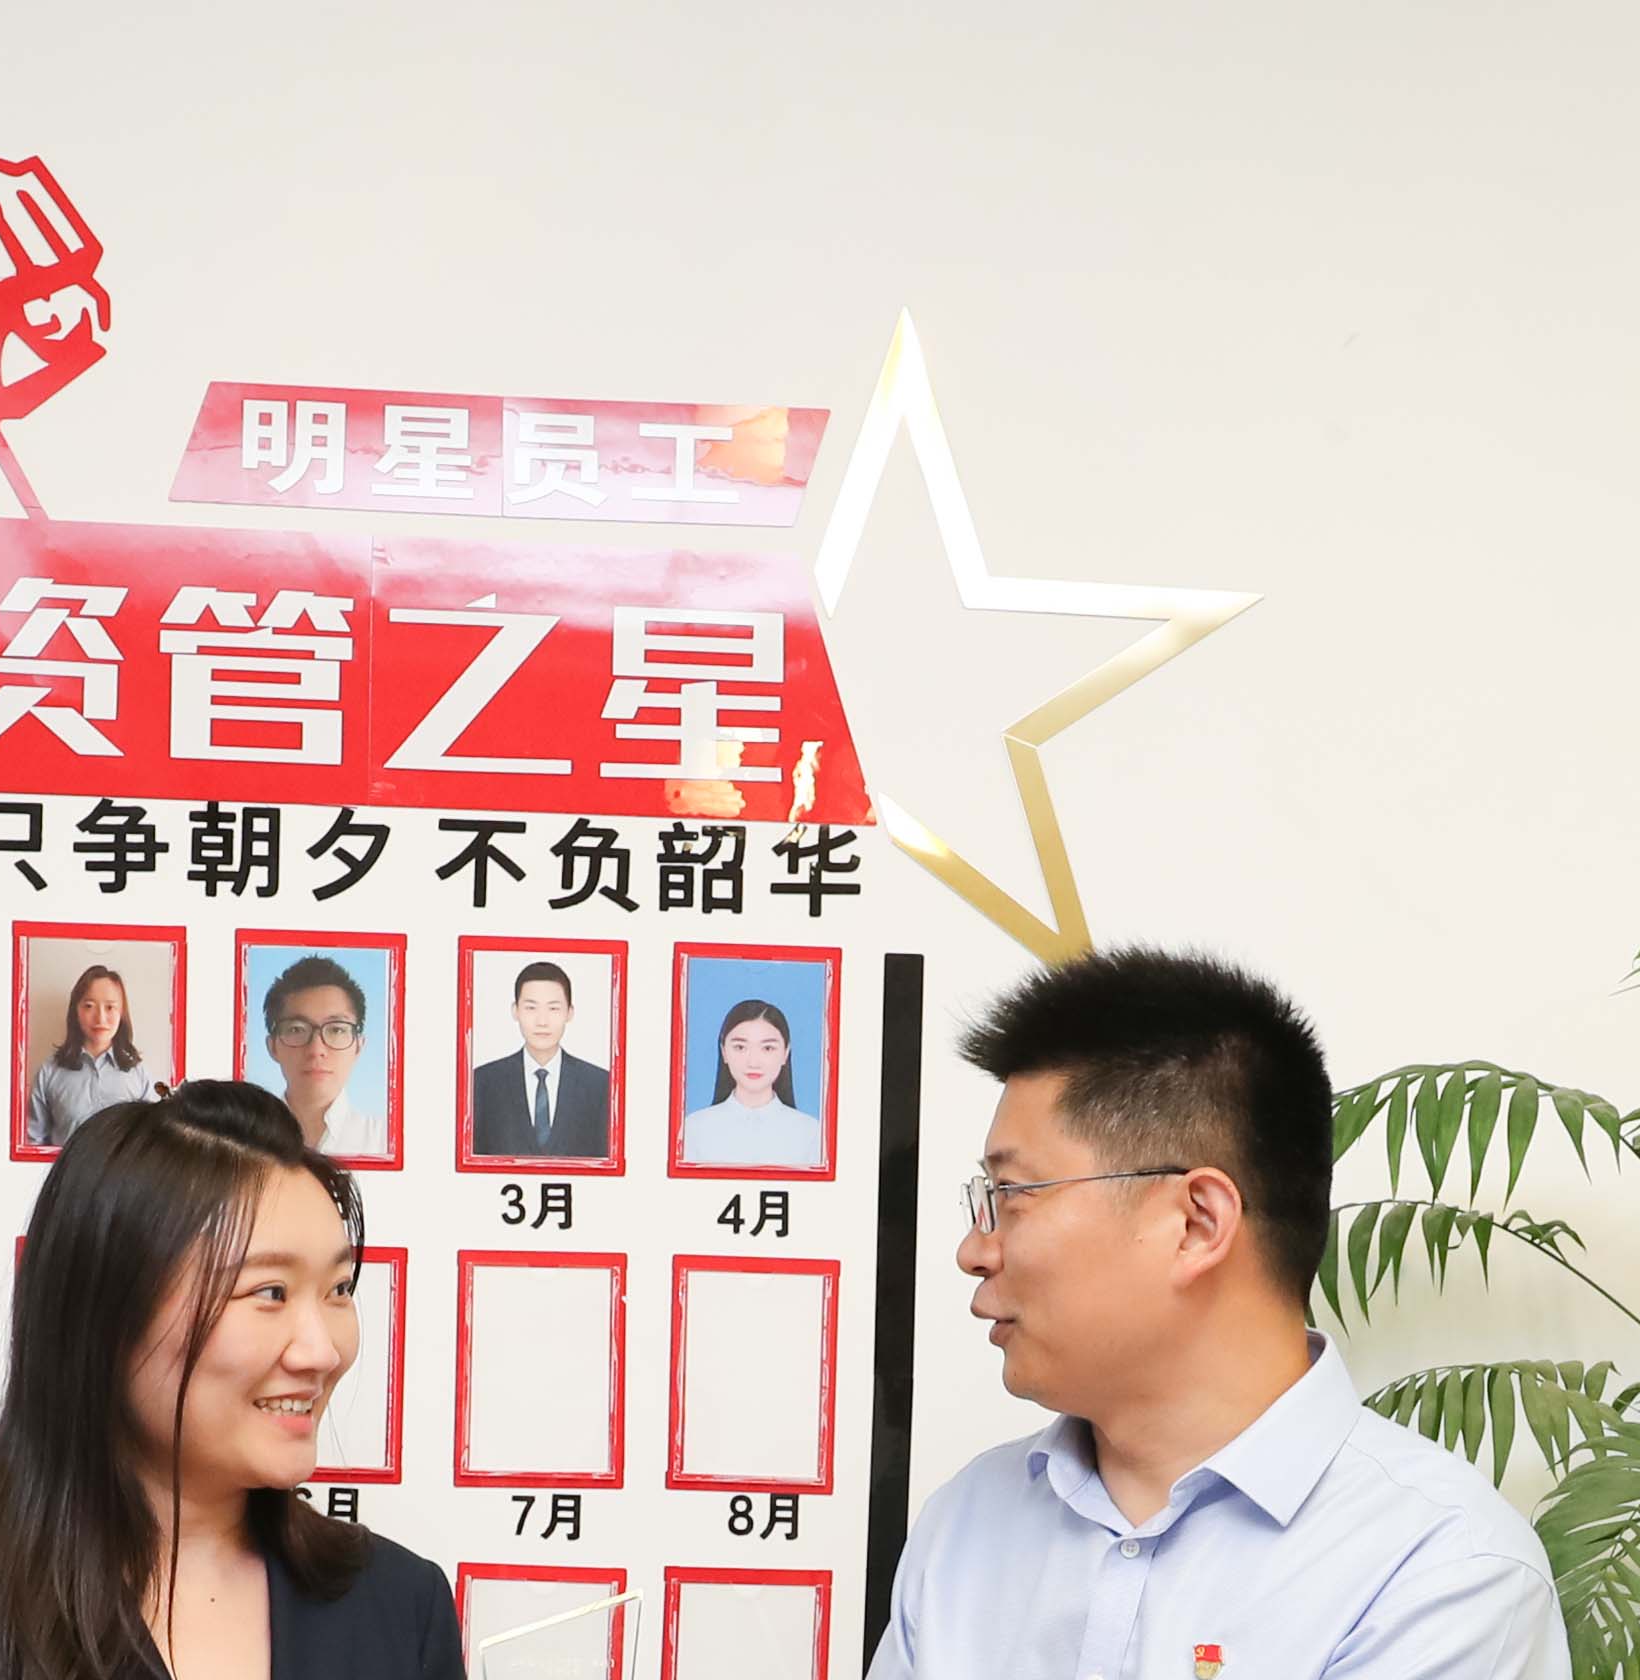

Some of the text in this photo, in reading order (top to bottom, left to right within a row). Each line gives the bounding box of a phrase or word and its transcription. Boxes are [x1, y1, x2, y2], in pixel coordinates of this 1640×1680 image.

[242, 399, 740, 507] 明星员工
[436, 818, 861, 918] 不负韶华
[500, 1184, 572, 1230] 3月
[717, 1191, 789, 1238] 4月
[511, 1495, 582, 1541] 7月
[728, 1493, 801, 1541] 8月
